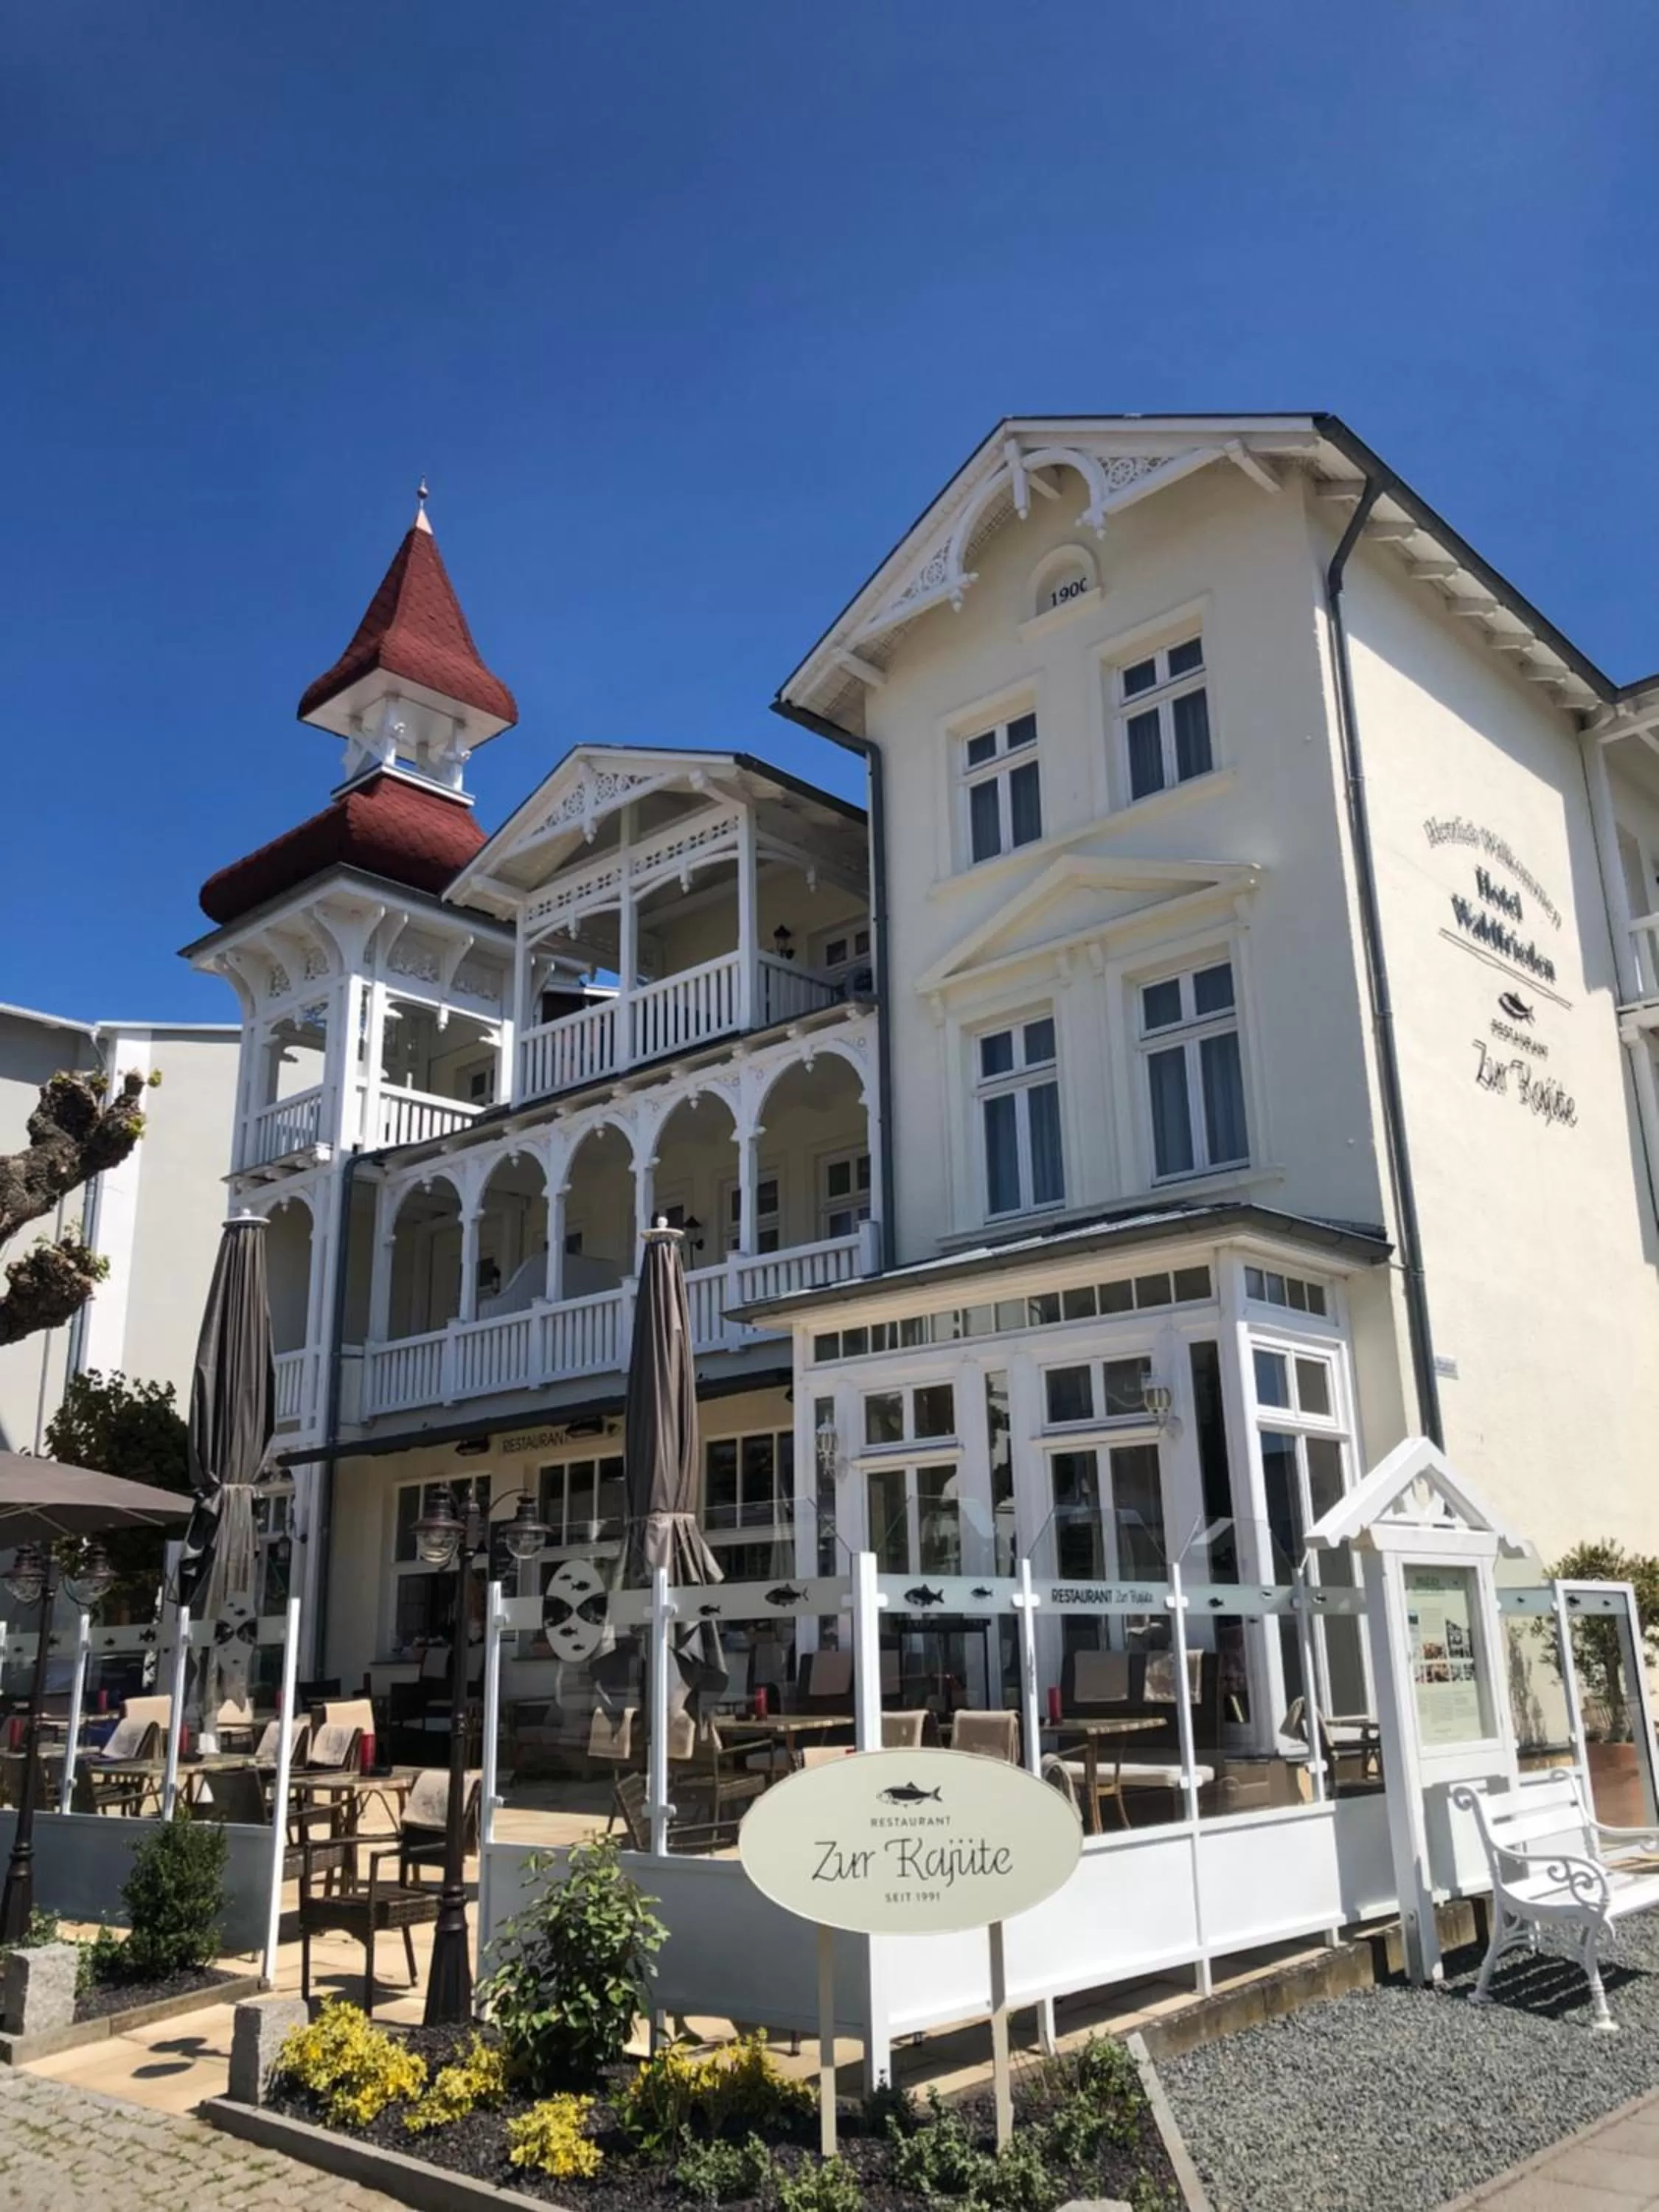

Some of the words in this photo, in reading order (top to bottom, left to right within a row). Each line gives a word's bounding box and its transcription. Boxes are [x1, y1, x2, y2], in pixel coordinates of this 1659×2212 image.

[1475, 864, 1523, 924] Hotel
[1472, 1038, 1508, 1097] Zur
[1509, 1059, 1579, 1128] Kajüte
[1051, 1588, 1113, 1604] RESTAURANT
[871, 1816, 951, 1827] RESTAURANT
[812, 1841, 876, 1881] Zur
[884, 1837, 1013, 1888] Kajüte
[885, 1893, 911, 1902] SEIT
[917, 1892, 941, 1902] 1991
